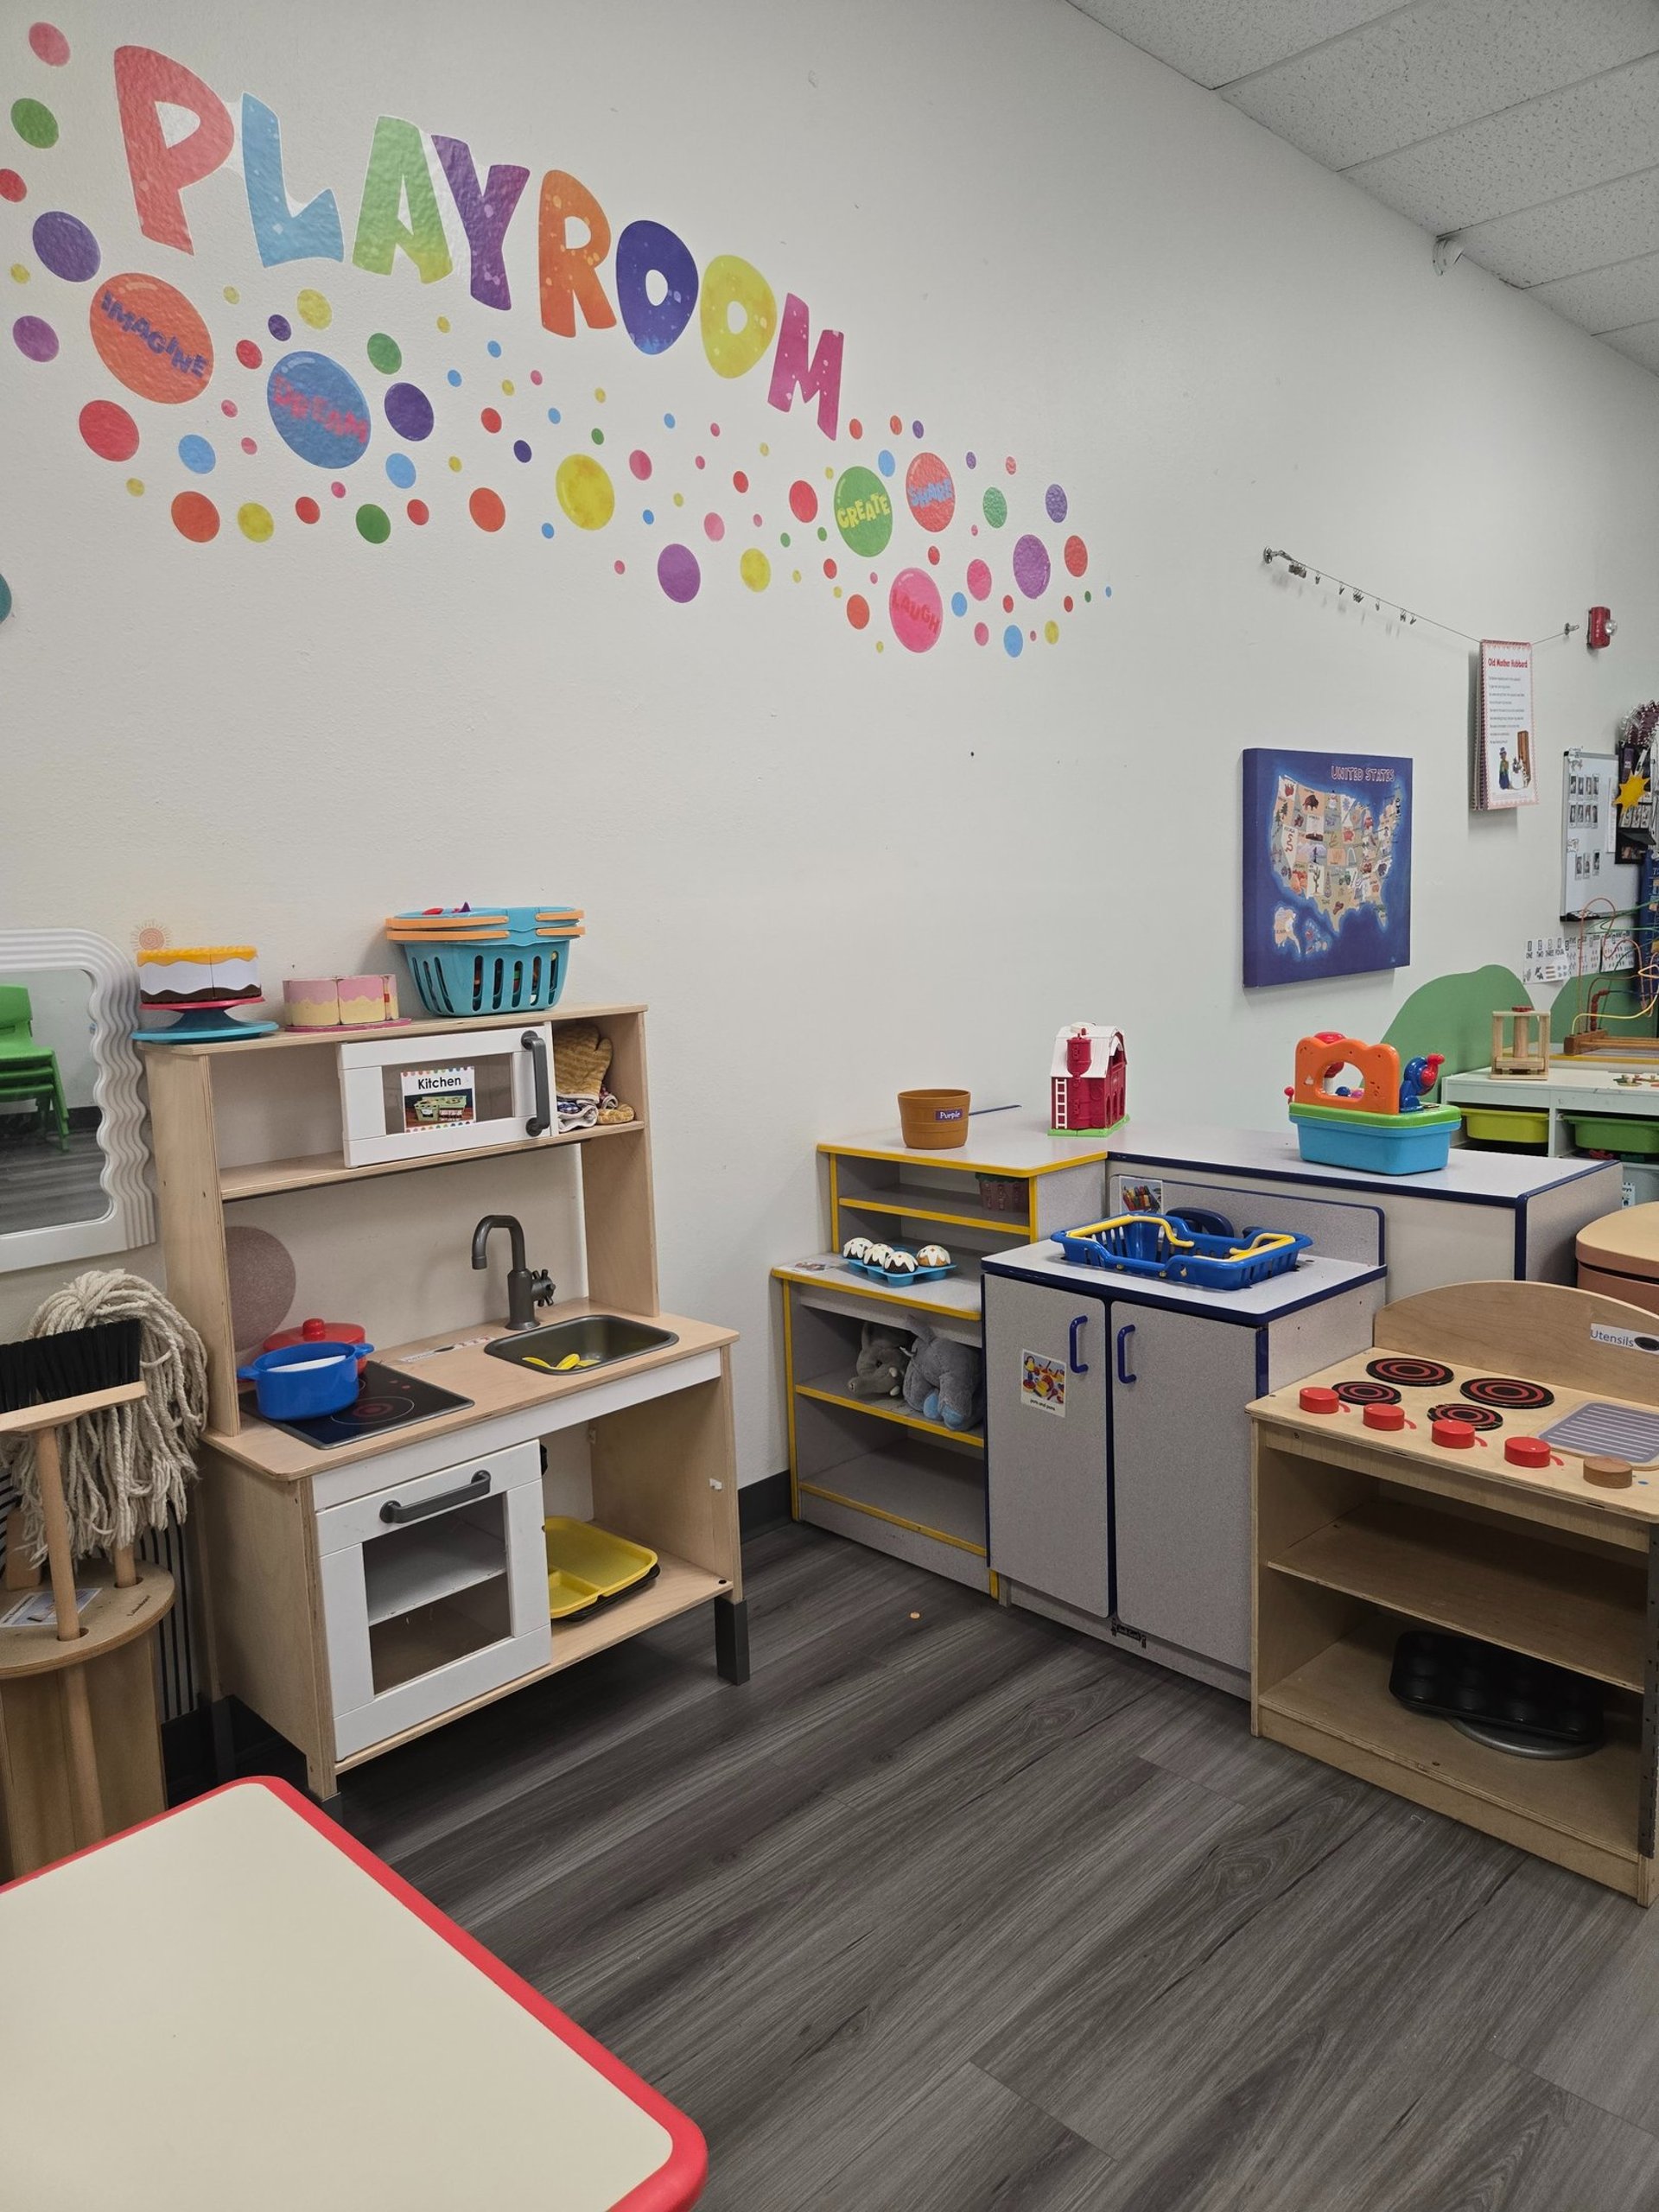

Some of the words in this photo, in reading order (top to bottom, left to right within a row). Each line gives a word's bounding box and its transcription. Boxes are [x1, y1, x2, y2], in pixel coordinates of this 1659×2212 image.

[114, 45, 844, 440] PLAYROOM
[101, 290, 209, 378] IMAGINE
[273, 373, 368, 444] DREAM
[836, 492, 891, 529] CREATE
[892, 589, 941, 635] LAUGH
[1331, 766, 1363, 781] UNITED
[1364, 767, 1395, 782] STATES
[417, 1077, 461, 1090] Kitchen
[939, 1110, 961, 1120] Purple
[1590, 1330, 1634, 1347] Utensils
